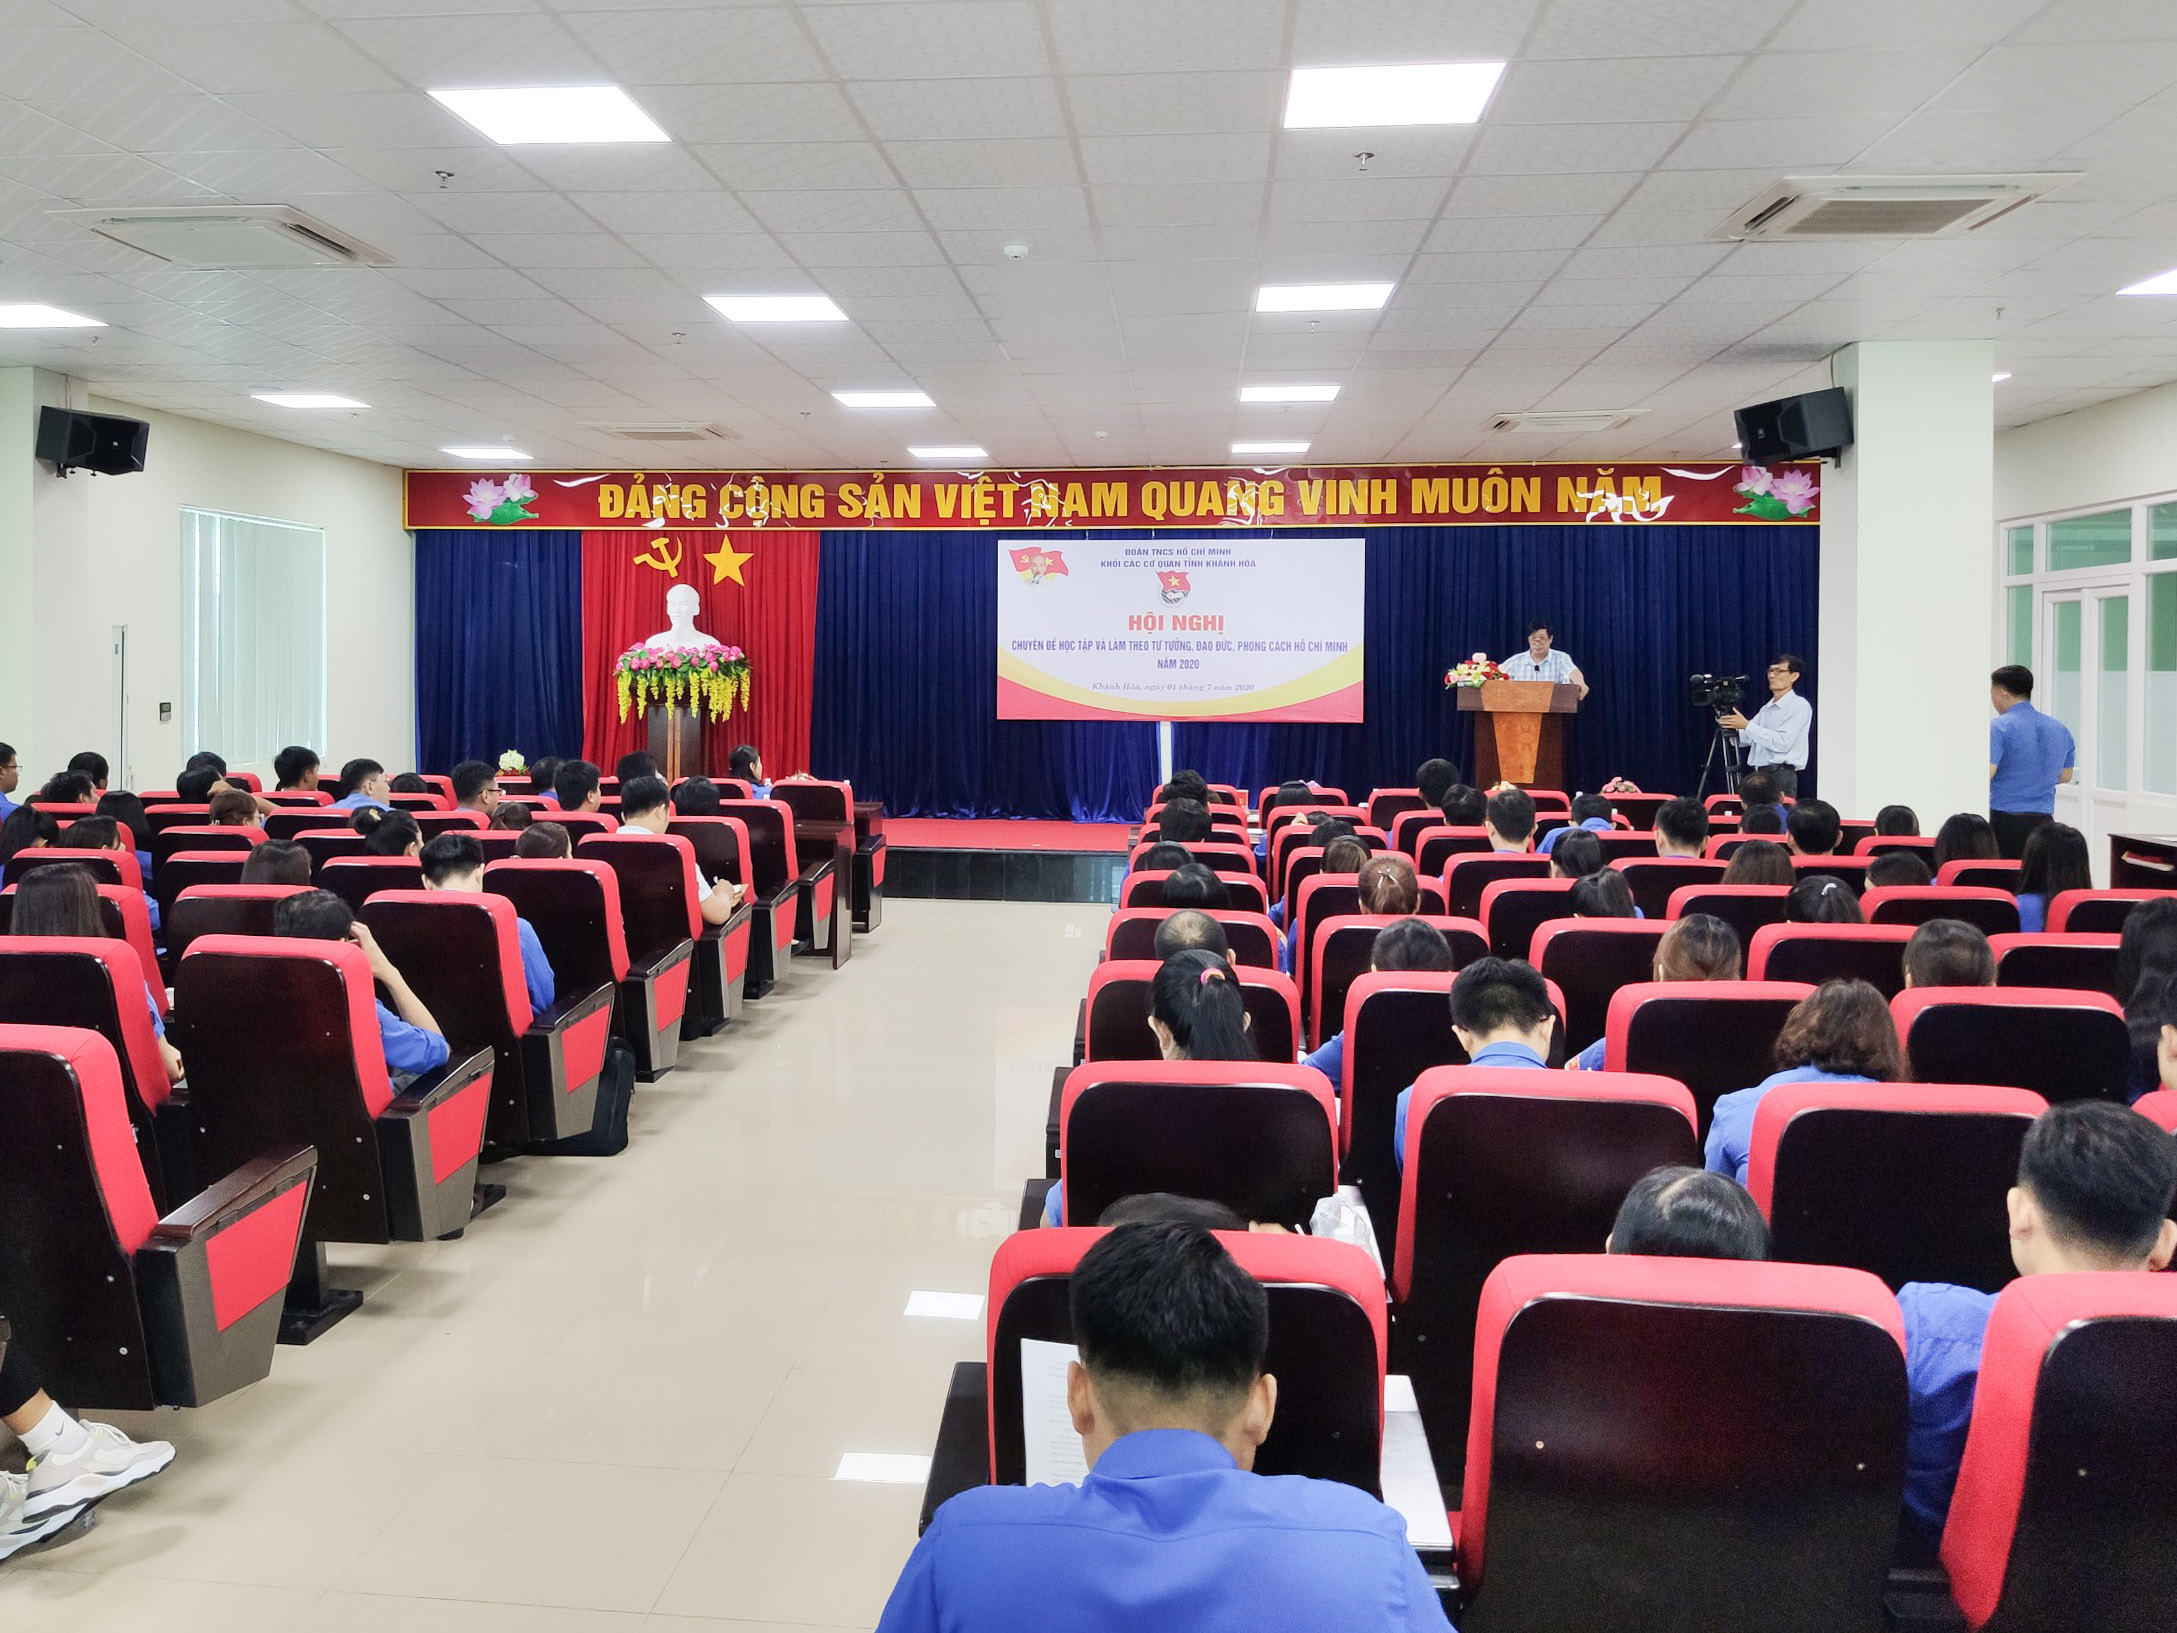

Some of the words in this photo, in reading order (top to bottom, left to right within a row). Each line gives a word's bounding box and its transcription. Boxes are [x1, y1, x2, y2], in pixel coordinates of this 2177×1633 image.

[597, 472, 707, 519] ĐẢNG
[719, 475, 825, 527] CỘNG
[837, 472, 921, 518] SẢN
[934, 475, 1020, 526] VIỆT
[1030, 482, 1128, 518] NAM
[1141, 480, 1285, 521] QUANG
[1297, 479, 1397, 516] VINH
[1411, 468, 1541, 514] MUÔN
[1556, 467, 1662, 514] NĂM
[1151, 548, 1174, 556] TNCS
[1190, 547, 1206, 556] CHÍ
[1208, 548, 1232, 556] MINH
[1123, 558, 1141, 568] CÁC
[1143, 559, 1156, 568] CƠ
[1157, 559, 1181, 568] QUAN
[1205, 558, 1236, 568] KHÁNH
[1128, 611, 1164, 635] HỘI
[1172, 614, 1224, 635] NGHỊ
[1011, 638, 1044, 651] CHUYÊN
[1058, 640, 1076, 654] HỌC
[1077, 638, 1094, 654] TẬP
[1095, 638, 1107, 651] VÀ
[1108, 638, 1127, 651] LÀM
[1128, 640, 1149, 651] THEO
[1151, 639, 1163, 652] TƯ
[1196, 640, 1214, 654] ĐẠO
[1237, 641, 1266, 652] PHONG
[1268, 639, 1292, 652] CÁCH
[1307, 640, 1323, 652] CHÍ
[1325, 641, 1349, 653] MINH
[1157, 657, 1177, 670] NĂM
[1179, 658, 1200, 670] 2020
[1207, 683, 1213, 692] 7
[1234, 684, 1255, 692] 2020
